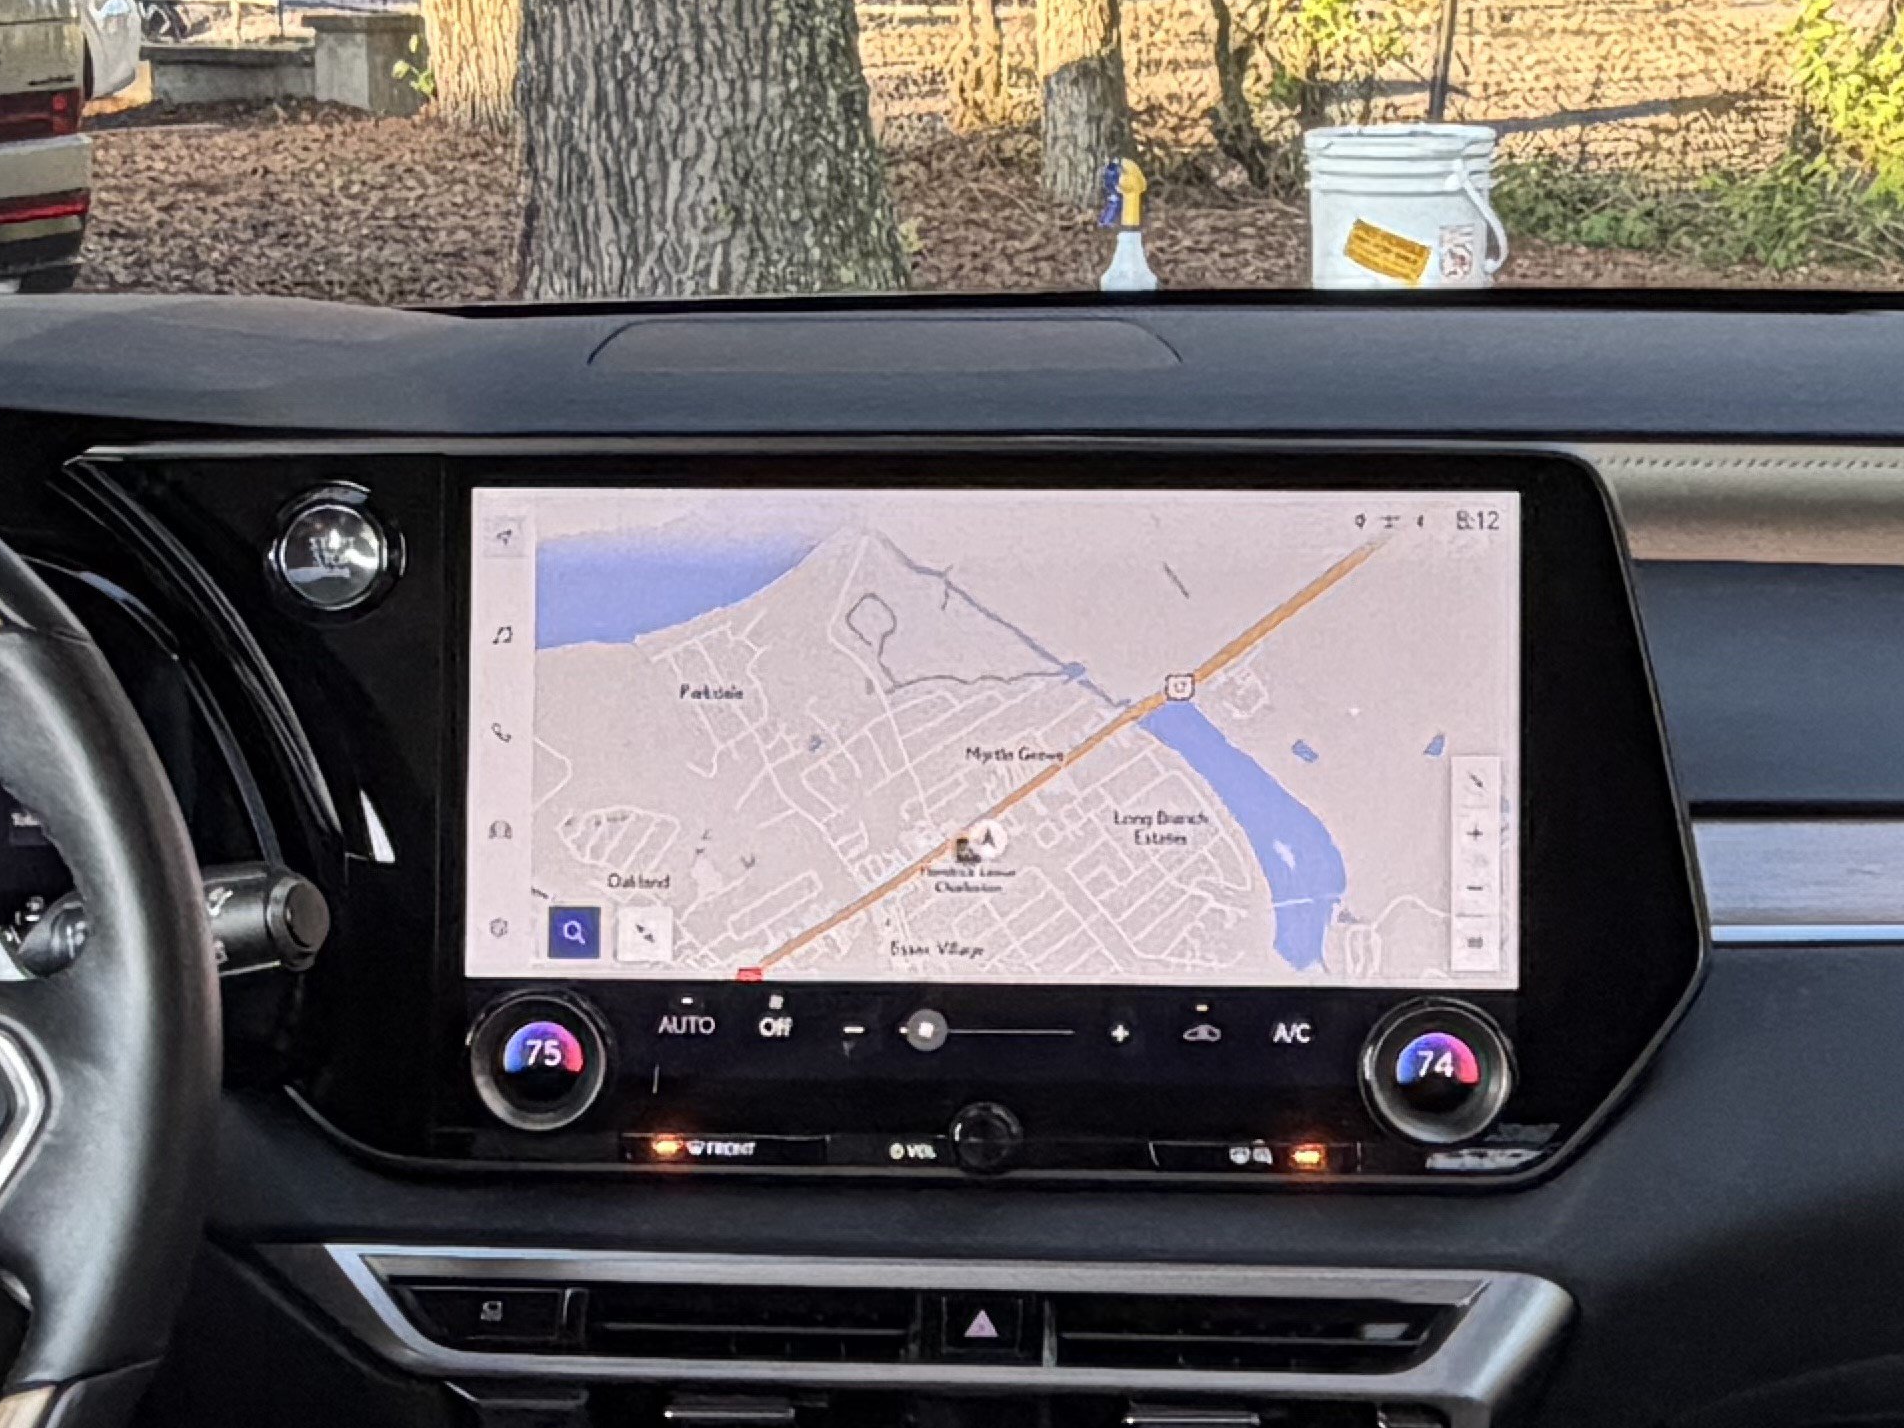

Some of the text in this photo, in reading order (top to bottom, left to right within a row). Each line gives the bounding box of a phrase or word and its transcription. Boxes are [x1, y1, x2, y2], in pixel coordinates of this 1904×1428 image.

[1456, 510, 1500, 530] 8:12
[1113, 811, 1152, 828] Long
[606, 872, 670, 889] Oakland
[937, 940, 984, 959] Village
[658, 1016, 793, 1037] AUTO Off
[1273, 1021, 1312, 1044] A/C
[525, 1038, 562, 1067] 75
[1418, 1049, 1455, 1078] 74
[705, 1141, 756, 1157] FRONT
[907, 1144, 937, 1158] VOL
